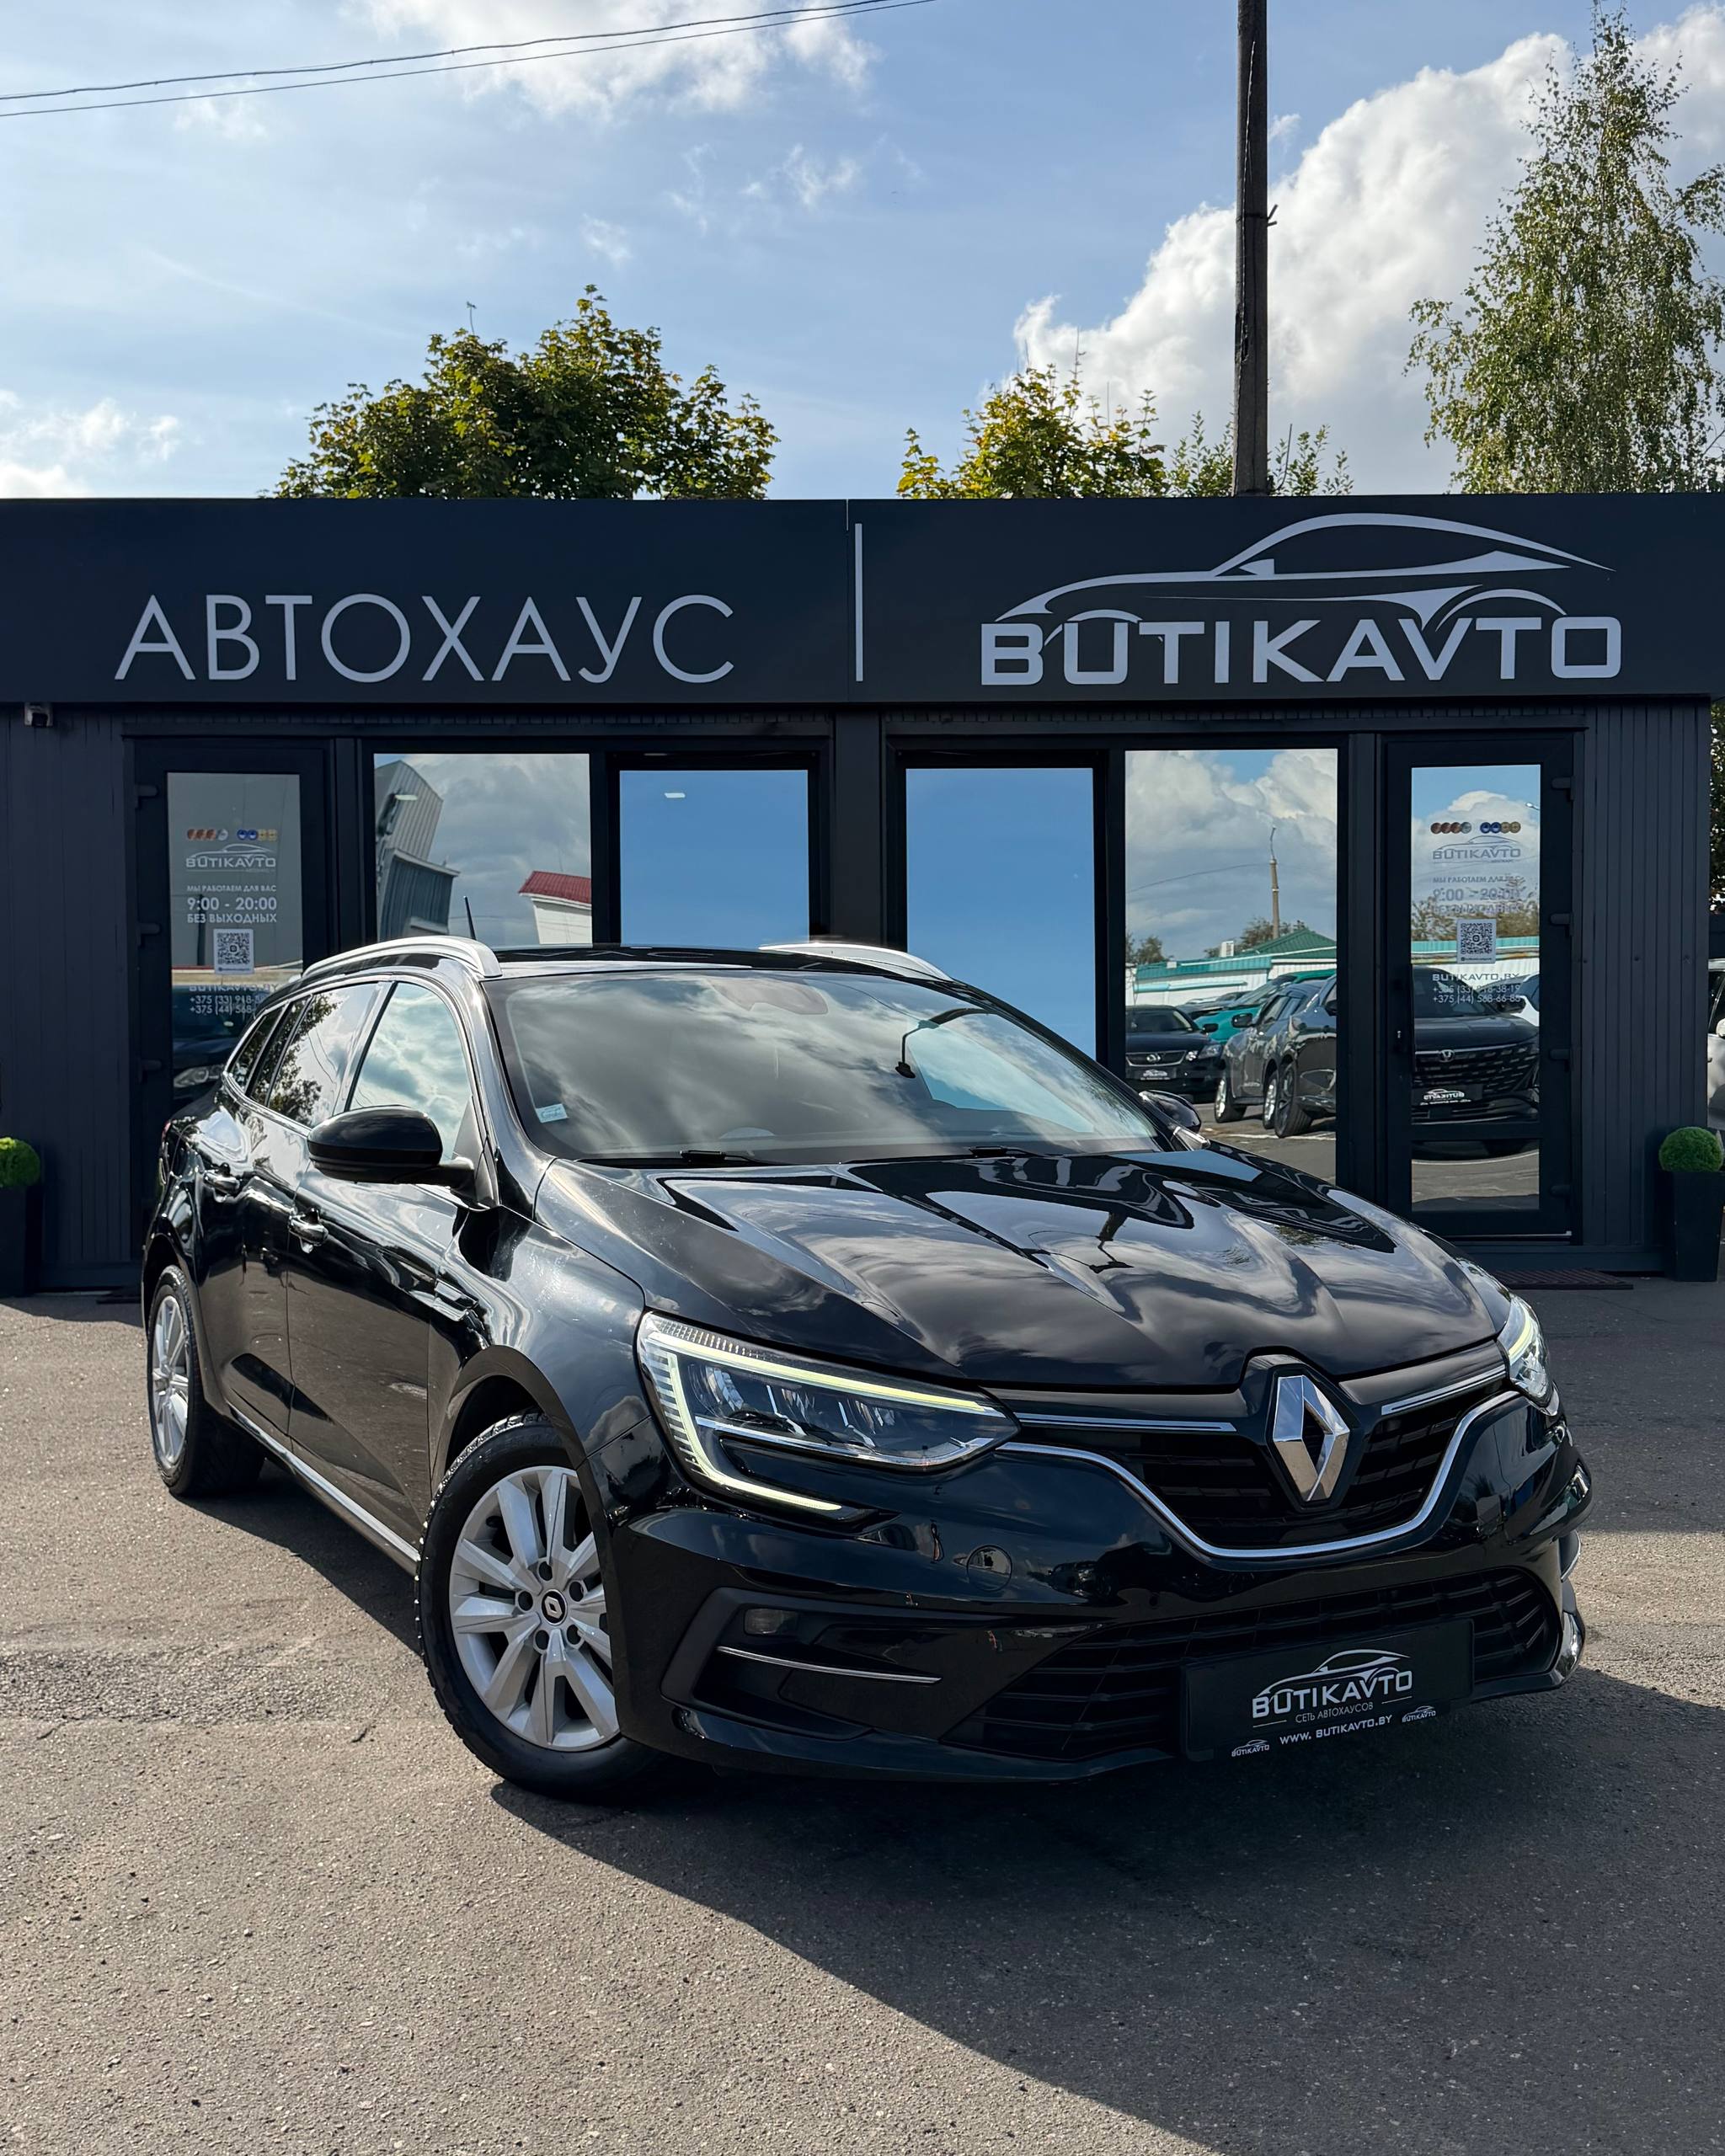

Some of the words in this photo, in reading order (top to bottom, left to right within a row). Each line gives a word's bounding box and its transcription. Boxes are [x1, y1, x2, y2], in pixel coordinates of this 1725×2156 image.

[115, 594, 734, 684] АВТОХАУС
[980, 616, 1621, 686] BUTIKAVTO
[1433, 849, 1520, 859] BUTIKAVTO
[185, 857, 276, 867] BUTIKAVTO
[187, 897, 219, 910] 9:00
[235, 897, 277, 910] 20:00
[187, 914, 206, 924] БЕЗ
[209, 914, 277, 924] ВЫХОДНЫХ
[190, 995, 212, 1005] +375
[215, 995, 232, 1006] (33)
[1433, 995, 1455, 1003] +375
[1457, 994, 1474, 1004] (44)
[190, 1005, 213, 1014] +375
[215, 1005, 232, 1015] (44)
[1252, 1670, 1413, 1719] BUTIKAVTO
[1295, 1712, 1316, 1724] СЕТЬ
[1317, 1702, 1375, 1720] АВТОХАУСОВ
[1402, 1710, 1437, 1722] BUTIKAVTO
[1279, 1732, 1312, 1745] WWW.
[1316, 1715, 1393, 1739] BUTIKAVTO.BY
[1231, 1744, 1270, 1757] BUTIKAVTO
